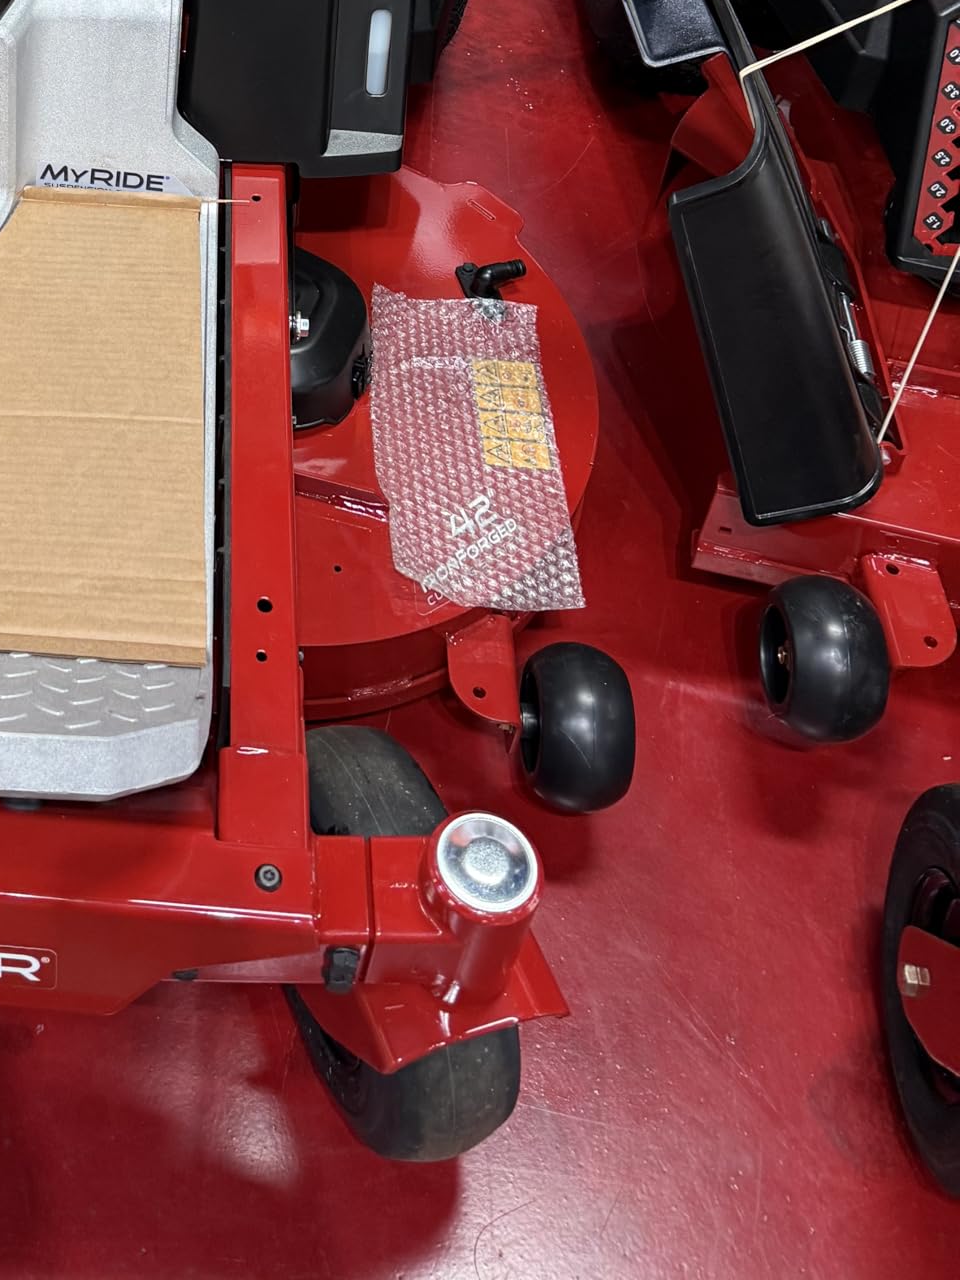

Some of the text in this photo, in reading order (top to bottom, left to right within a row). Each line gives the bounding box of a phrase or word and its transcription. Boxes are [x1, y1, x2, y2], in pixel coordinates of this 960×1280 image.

[944, 83, 960, 99] 3.5
[940, 118, 955, 133] 3.0
[935, 151, 951, 165] 2.5
[926, 215, 941, 229] 1.5
